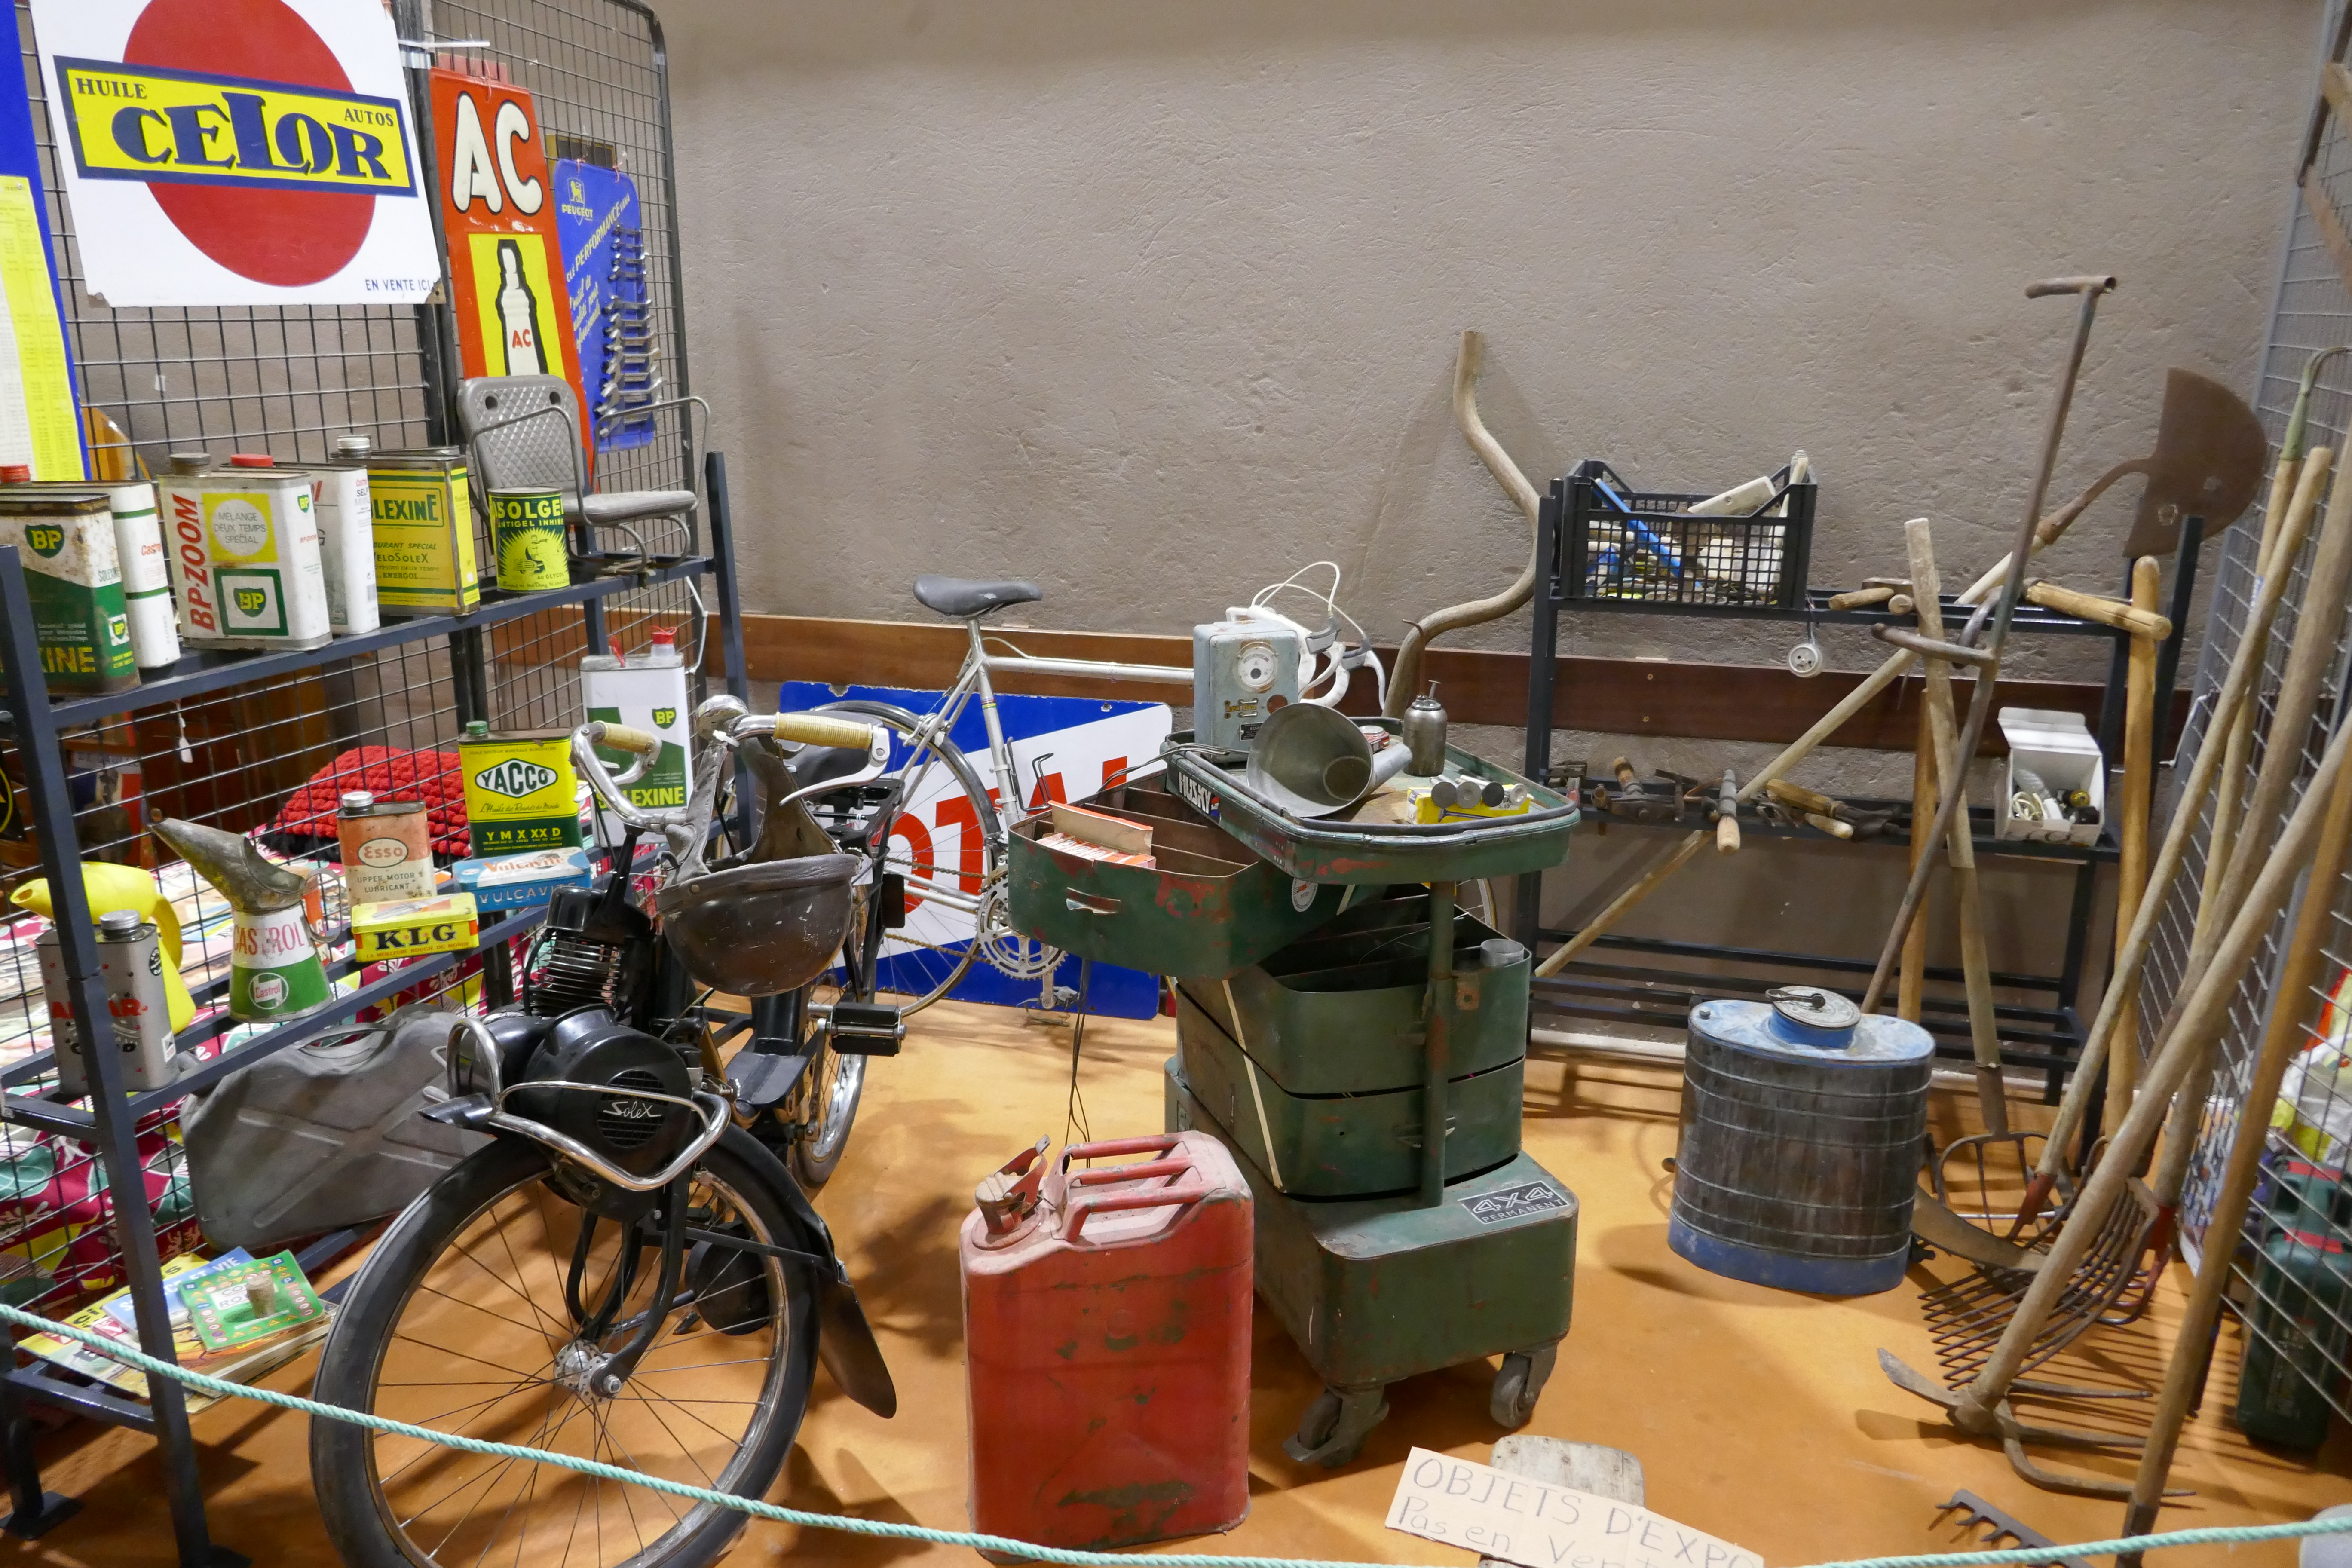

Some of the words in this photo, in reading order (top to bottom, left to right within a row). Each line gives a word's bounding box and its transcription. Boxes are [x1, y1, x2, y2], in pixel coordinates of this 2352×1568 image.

[75, 77, 147, 99] HUILE
[343, 108, 395, 127] AUTOS
[111, 91, 392, 180] CELOR
[451, 91, 543, 215] AC
[561, 204, 594, 218] PEUGEOT
[575, 201, 620, 272] PERFORMANCE
[365, 279, 379, 291] EN
[383, 279, 415, 291] VENTE
[511, 328, 533, 349] AC
[299, 496, 309, 510] BP
[371, 494, 438, 521] LEXINE
[214, 524, 236, 533] DEUX
[239, 524, 266, 533] TEMPS
[498, 520, 535, 528] ANTIGEL
[30, 530, 62, 550] BP
[238, 592, 265, 610] BP
[114, 623, 125, 635] BP
[655, 710, 676, 725] BP
[481, 762, 549, 795] YACCO
[596, 787, 685, 809] SEXINE
[1179, 772, 1211, 814] HUSKY
[486, 831, 495, 841] Y
[500, 830, 512, 840] M
[517, 829, 526, 839] X
[530, 828, 548, 838] XX
[551, 827, 561, 837] D
[482, 856, 565, 872] Vulcavite
[387, 872, 415, 881] MOTOR
[364, 882, 410, 893] LUBRICANT
[255, 983, 282, 999] Castrol
[1481, 1199, 1564, 1222] PERMANENT
[212, 1257, 241, 1271] VIE
[1412, 1458, 1582, 1525] OBJETS
[1398, 1496, 1447, 1535] Pas
[1465, 1525, 1510, 1553] en
